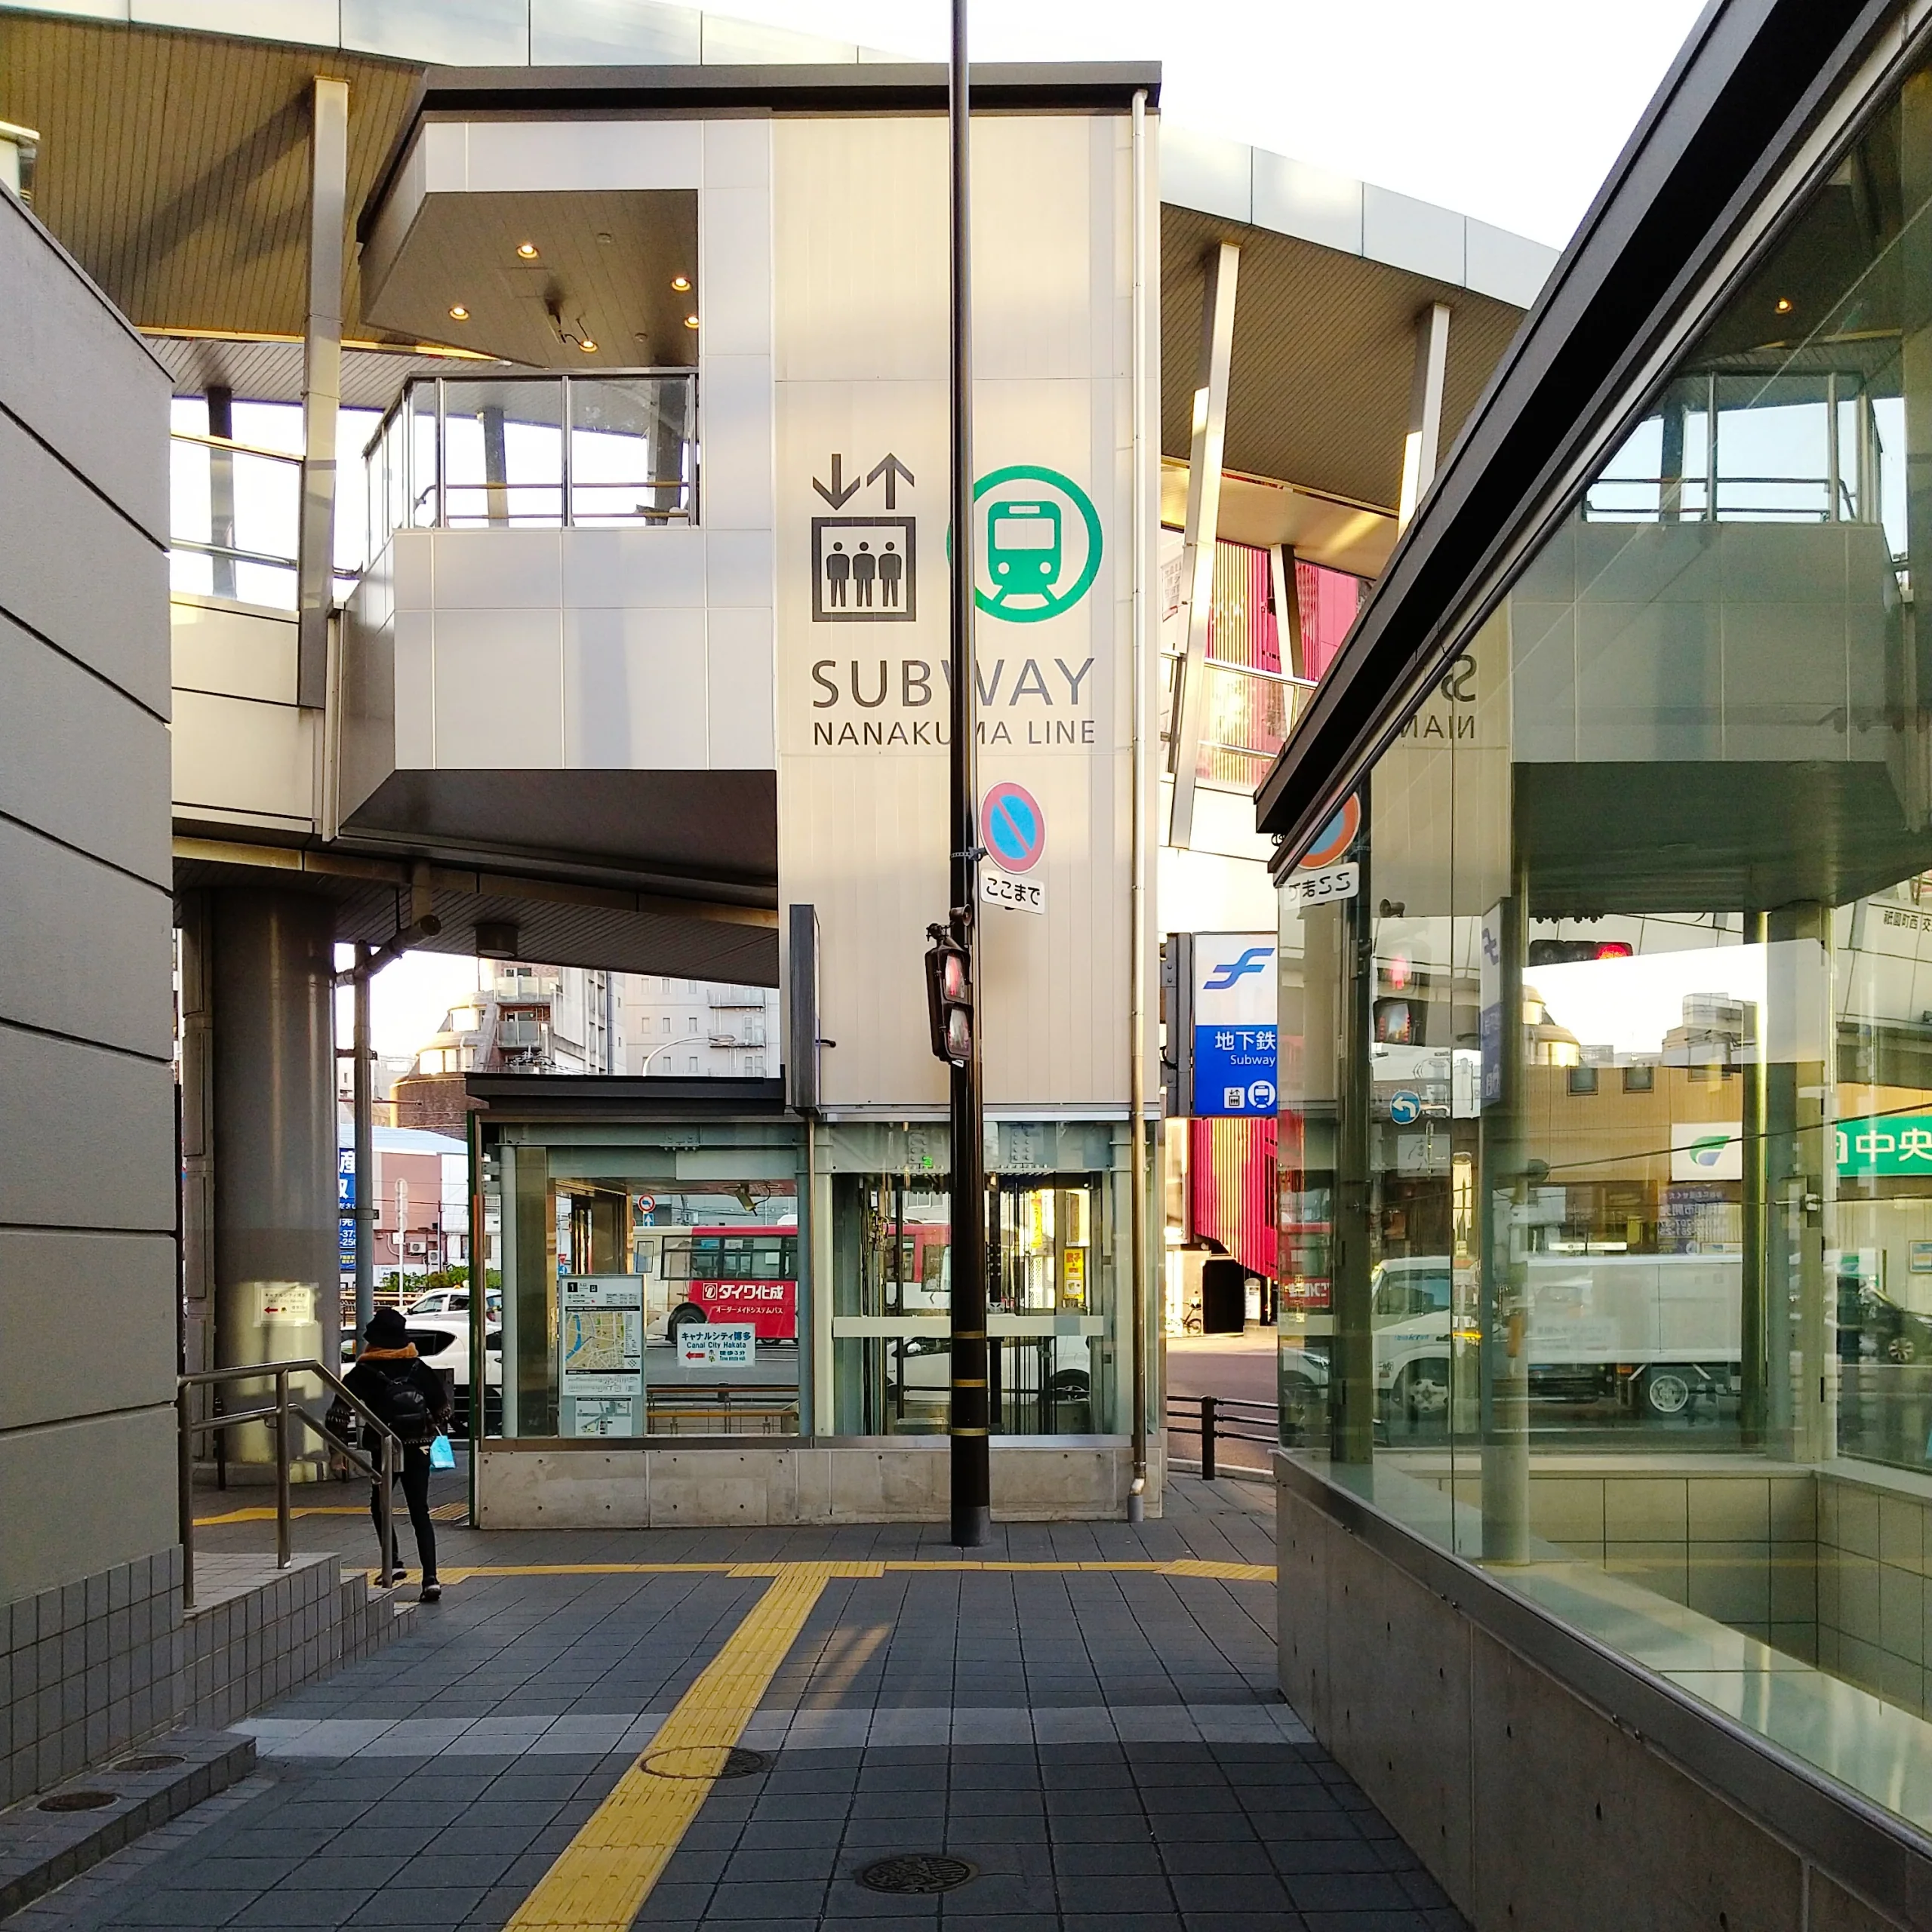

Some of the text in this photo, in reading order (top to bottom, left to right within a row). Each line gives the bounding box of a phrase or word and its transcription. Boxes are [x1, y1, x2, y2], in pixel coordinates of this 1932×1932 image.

[811, 657, 1095, 708] SUBWAY
[1028, 720, 1095, 744] LINE
[986, 877, 1041, 906] ここまで
[1883, 910, 1932, 933] 祇園町西交
[1214, 1030, 1276, 1051] 地下鉄
[1230, 1054, 1276, 1068] Subway
[718, 1284, 784, 1300] ダイワ化成
[681, 1331, 752, 1341] キャナルシティ博多
